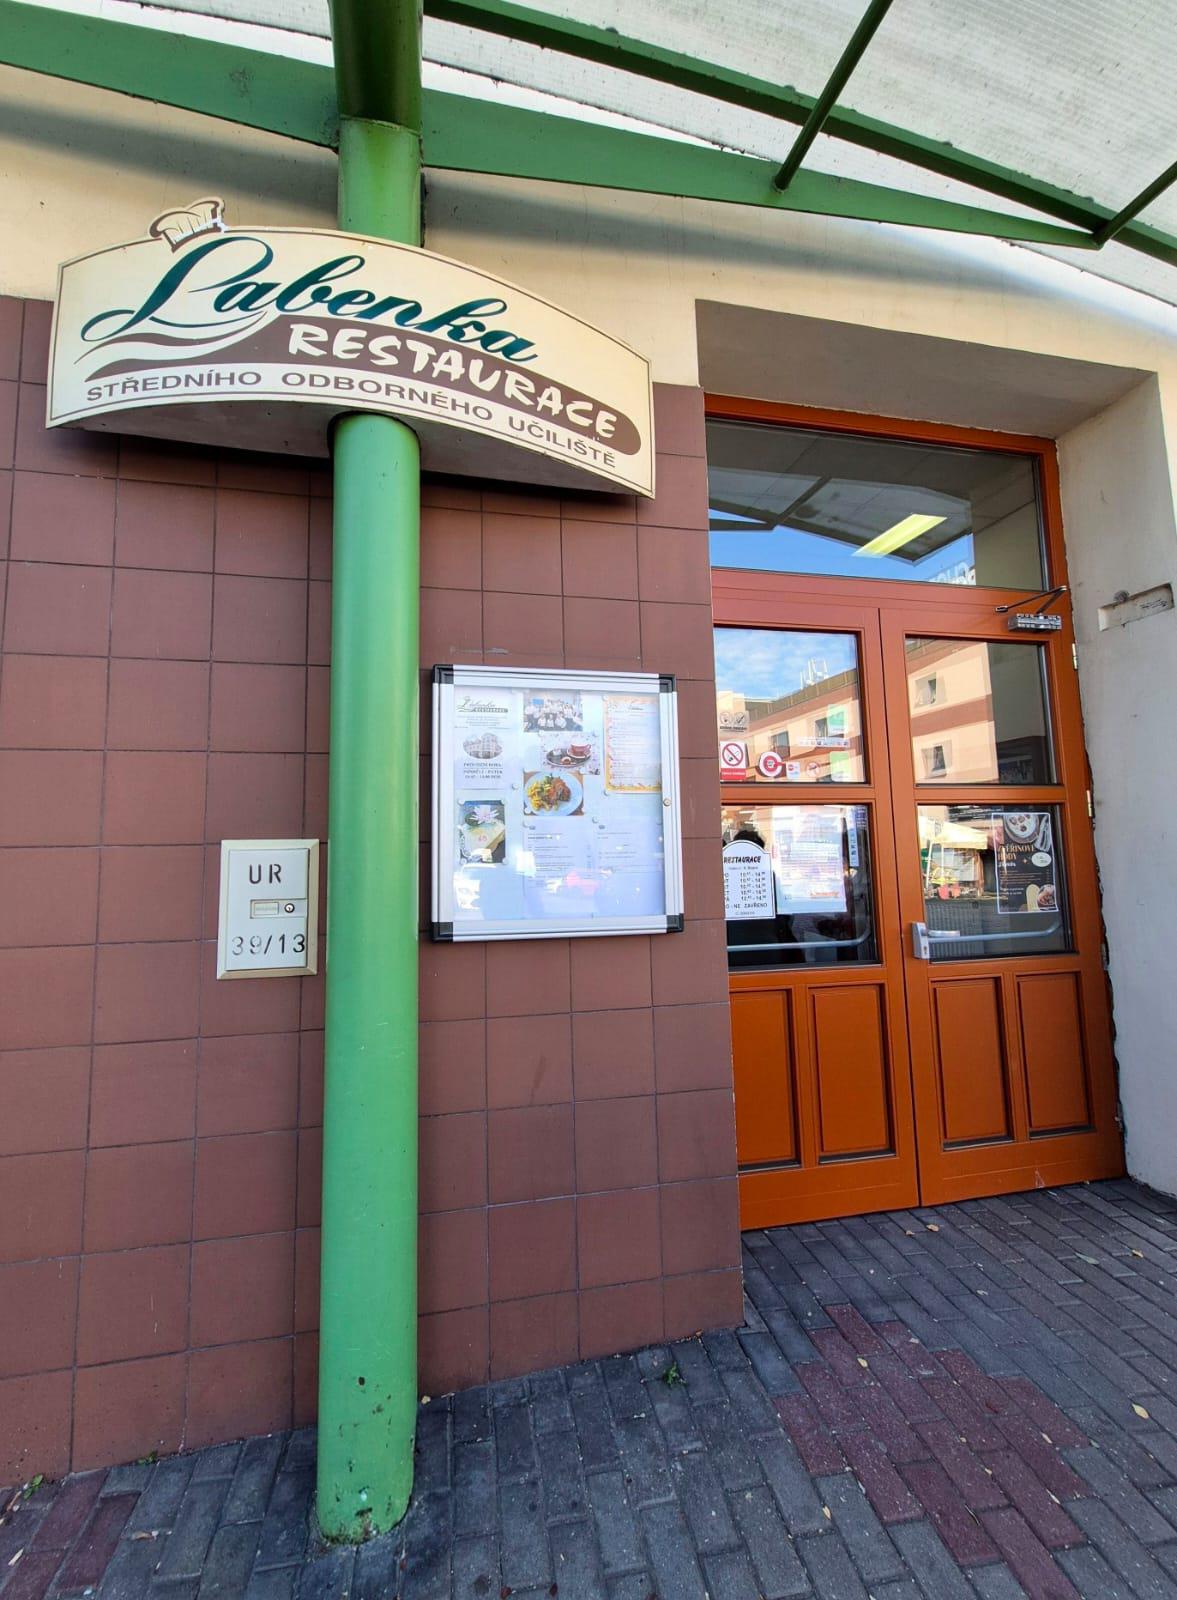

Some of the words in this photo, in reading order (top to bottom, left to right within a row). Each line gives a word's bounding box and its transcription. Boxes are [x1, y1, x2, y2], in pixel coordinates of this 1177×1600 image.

[80, 236, 540, 364] Labenka
[86, 368, 262, 402] STŘEDNÍHO
[281, 375, 494, 421] ODBORNÉHO
[508, 414, 617, 469] UČILIŠTĚ
[289, 323, 618, 440] RESTAURACE
[249, 863, 282, 884] UR
[232, 933, 306, 956] 39/13
